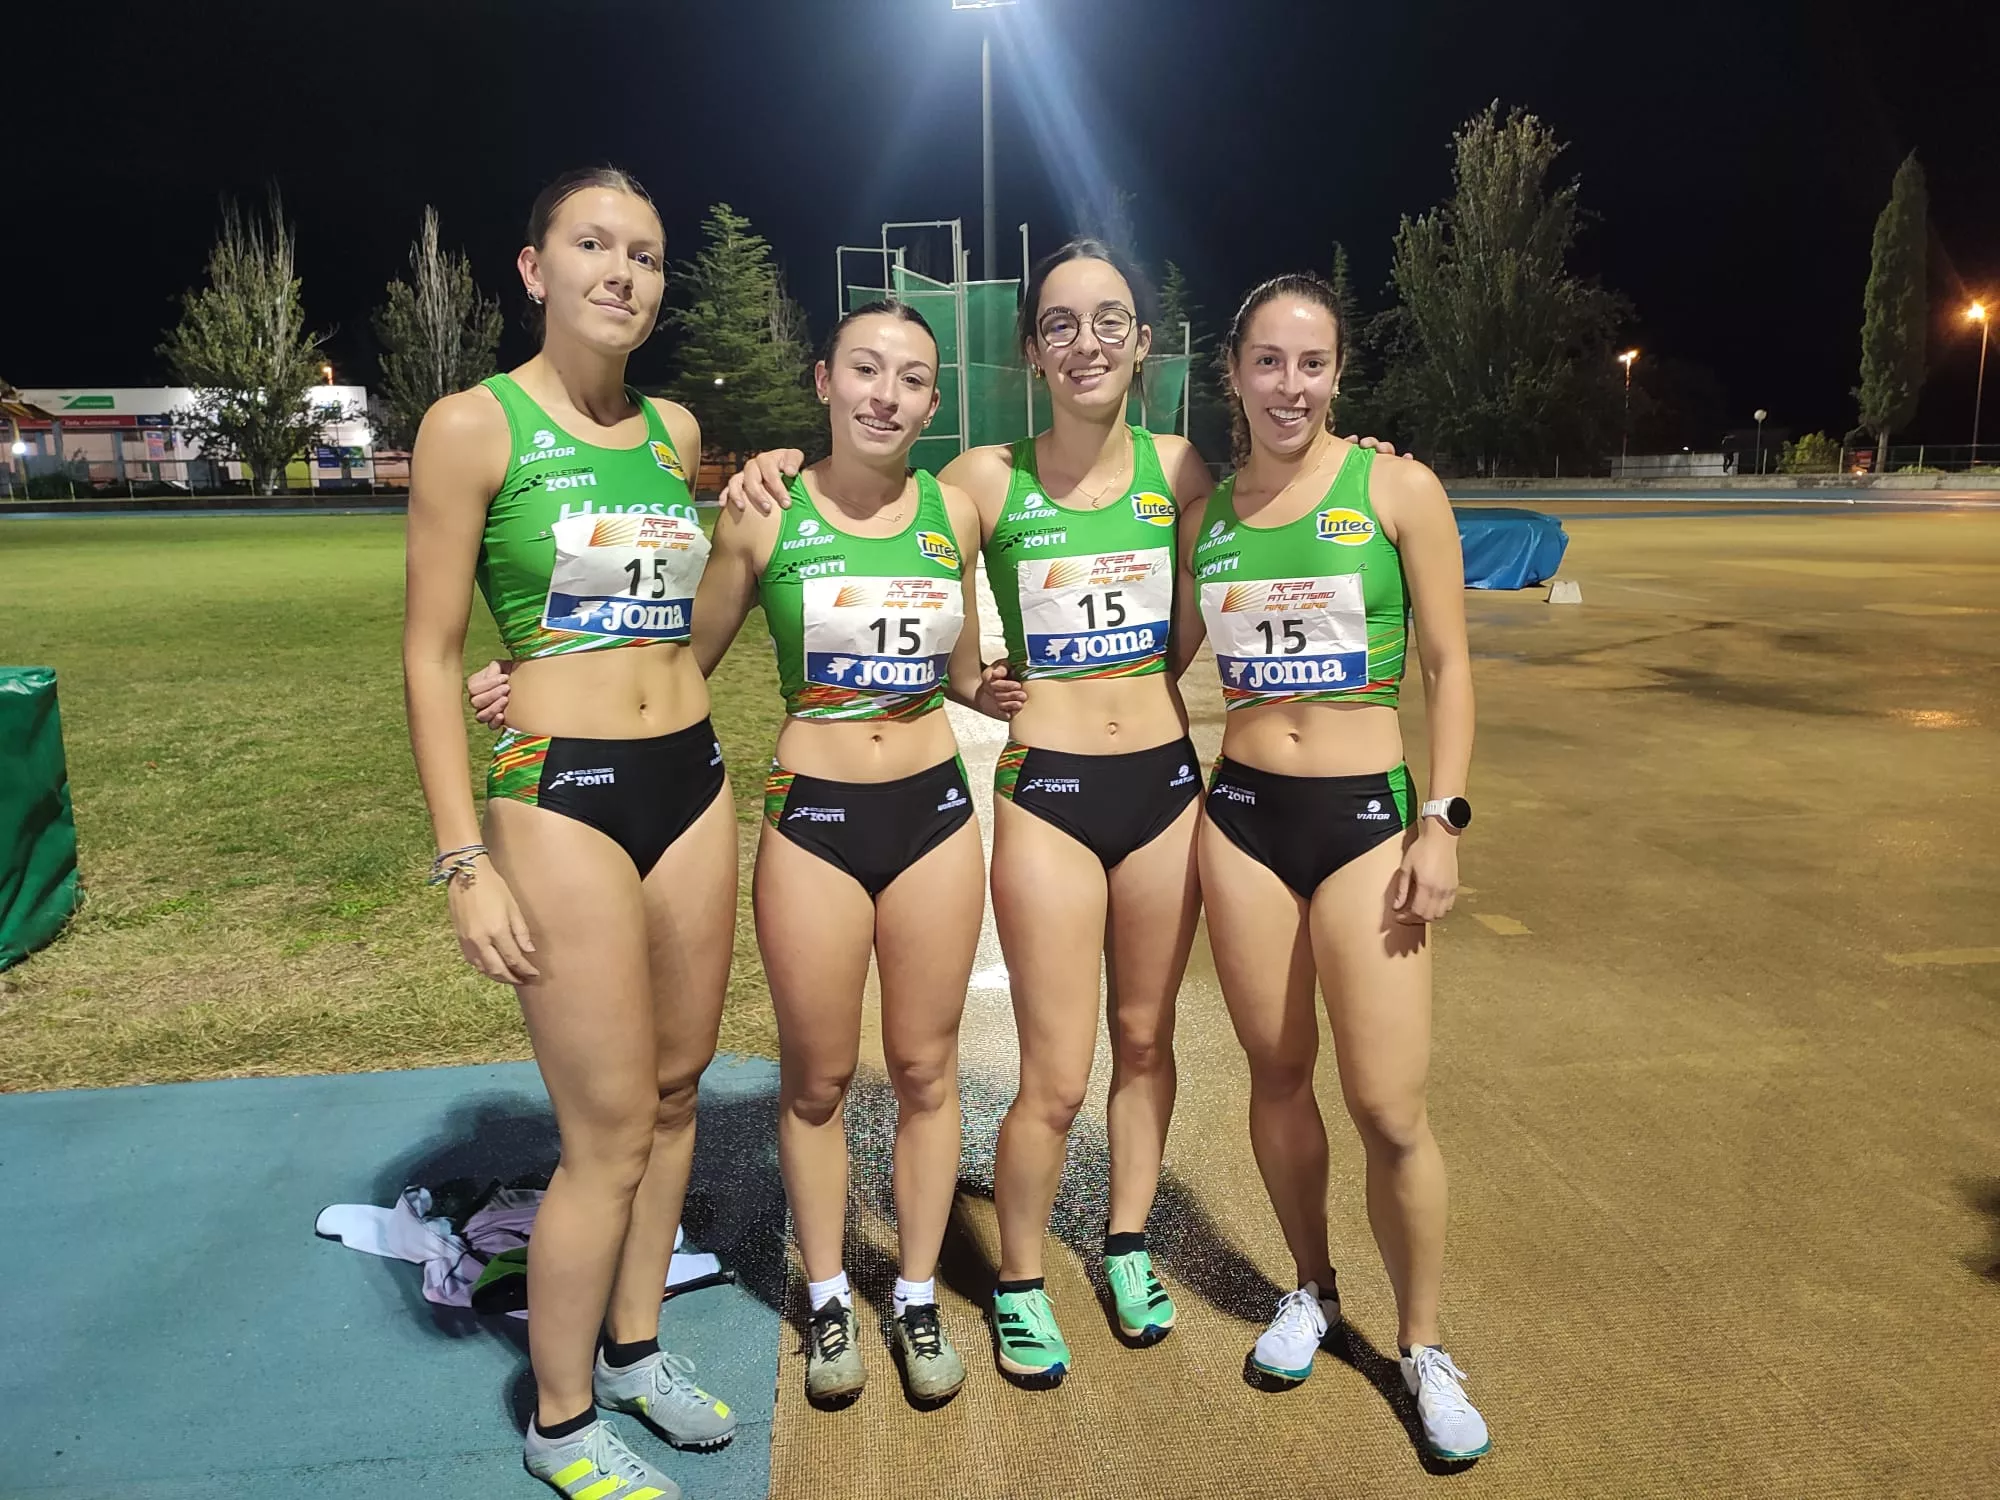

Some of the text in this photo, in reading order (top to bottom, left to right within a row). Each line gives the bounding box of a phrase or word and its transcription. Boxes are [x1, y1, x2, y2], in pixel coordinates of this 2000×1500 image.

[519, 446, 576, 465] VIATOR
[544, 466, 594, 478] ATLETISMO
[544, 473, 597, 492] ZOITI
[1007, 508, 1058, 521] VIATOR
[1136, 500, 1176, 515] Intec
[1023, 526, 1067, 537] ATLETISMO
[1320, 517, 1373, 533] Intec
[782, 534, 835, 551] VIATOR
[1023, 532, 1067, 549] ZOITI
[799, 554, 846, 566] ATLETISMO
[1199, 557, 1239, 579] ZOITI
[799, 561, 846, 579] ZOITI
[624, 558, 668, 599] 15
[1270, 581, 1315, 593] RFEA
[1267, 591, 1336, 602] ATLETISMO
[1077, 590, 1126, 630] 15
[1264, 601, 1329, 611] AIRE LIBRE
[601, 601, 686, 631] Joma
[868, 617, 921, 656] 15
[1255, 619, 1307, 655] 15
[1071, 628, 1156, 663] Joma
[854, 659, 936, 687] Joma
[1249, 658, 1347, 688] Joma
[575, 773, 615, 787] ZOITI
[1044, 783, 1080, 793] ZOITI
[1227, 791, 1256, 806] ZOITI
[809, 812, 845, 822] ZOITI
[1356, 812, 1391, 821] VIATOR
